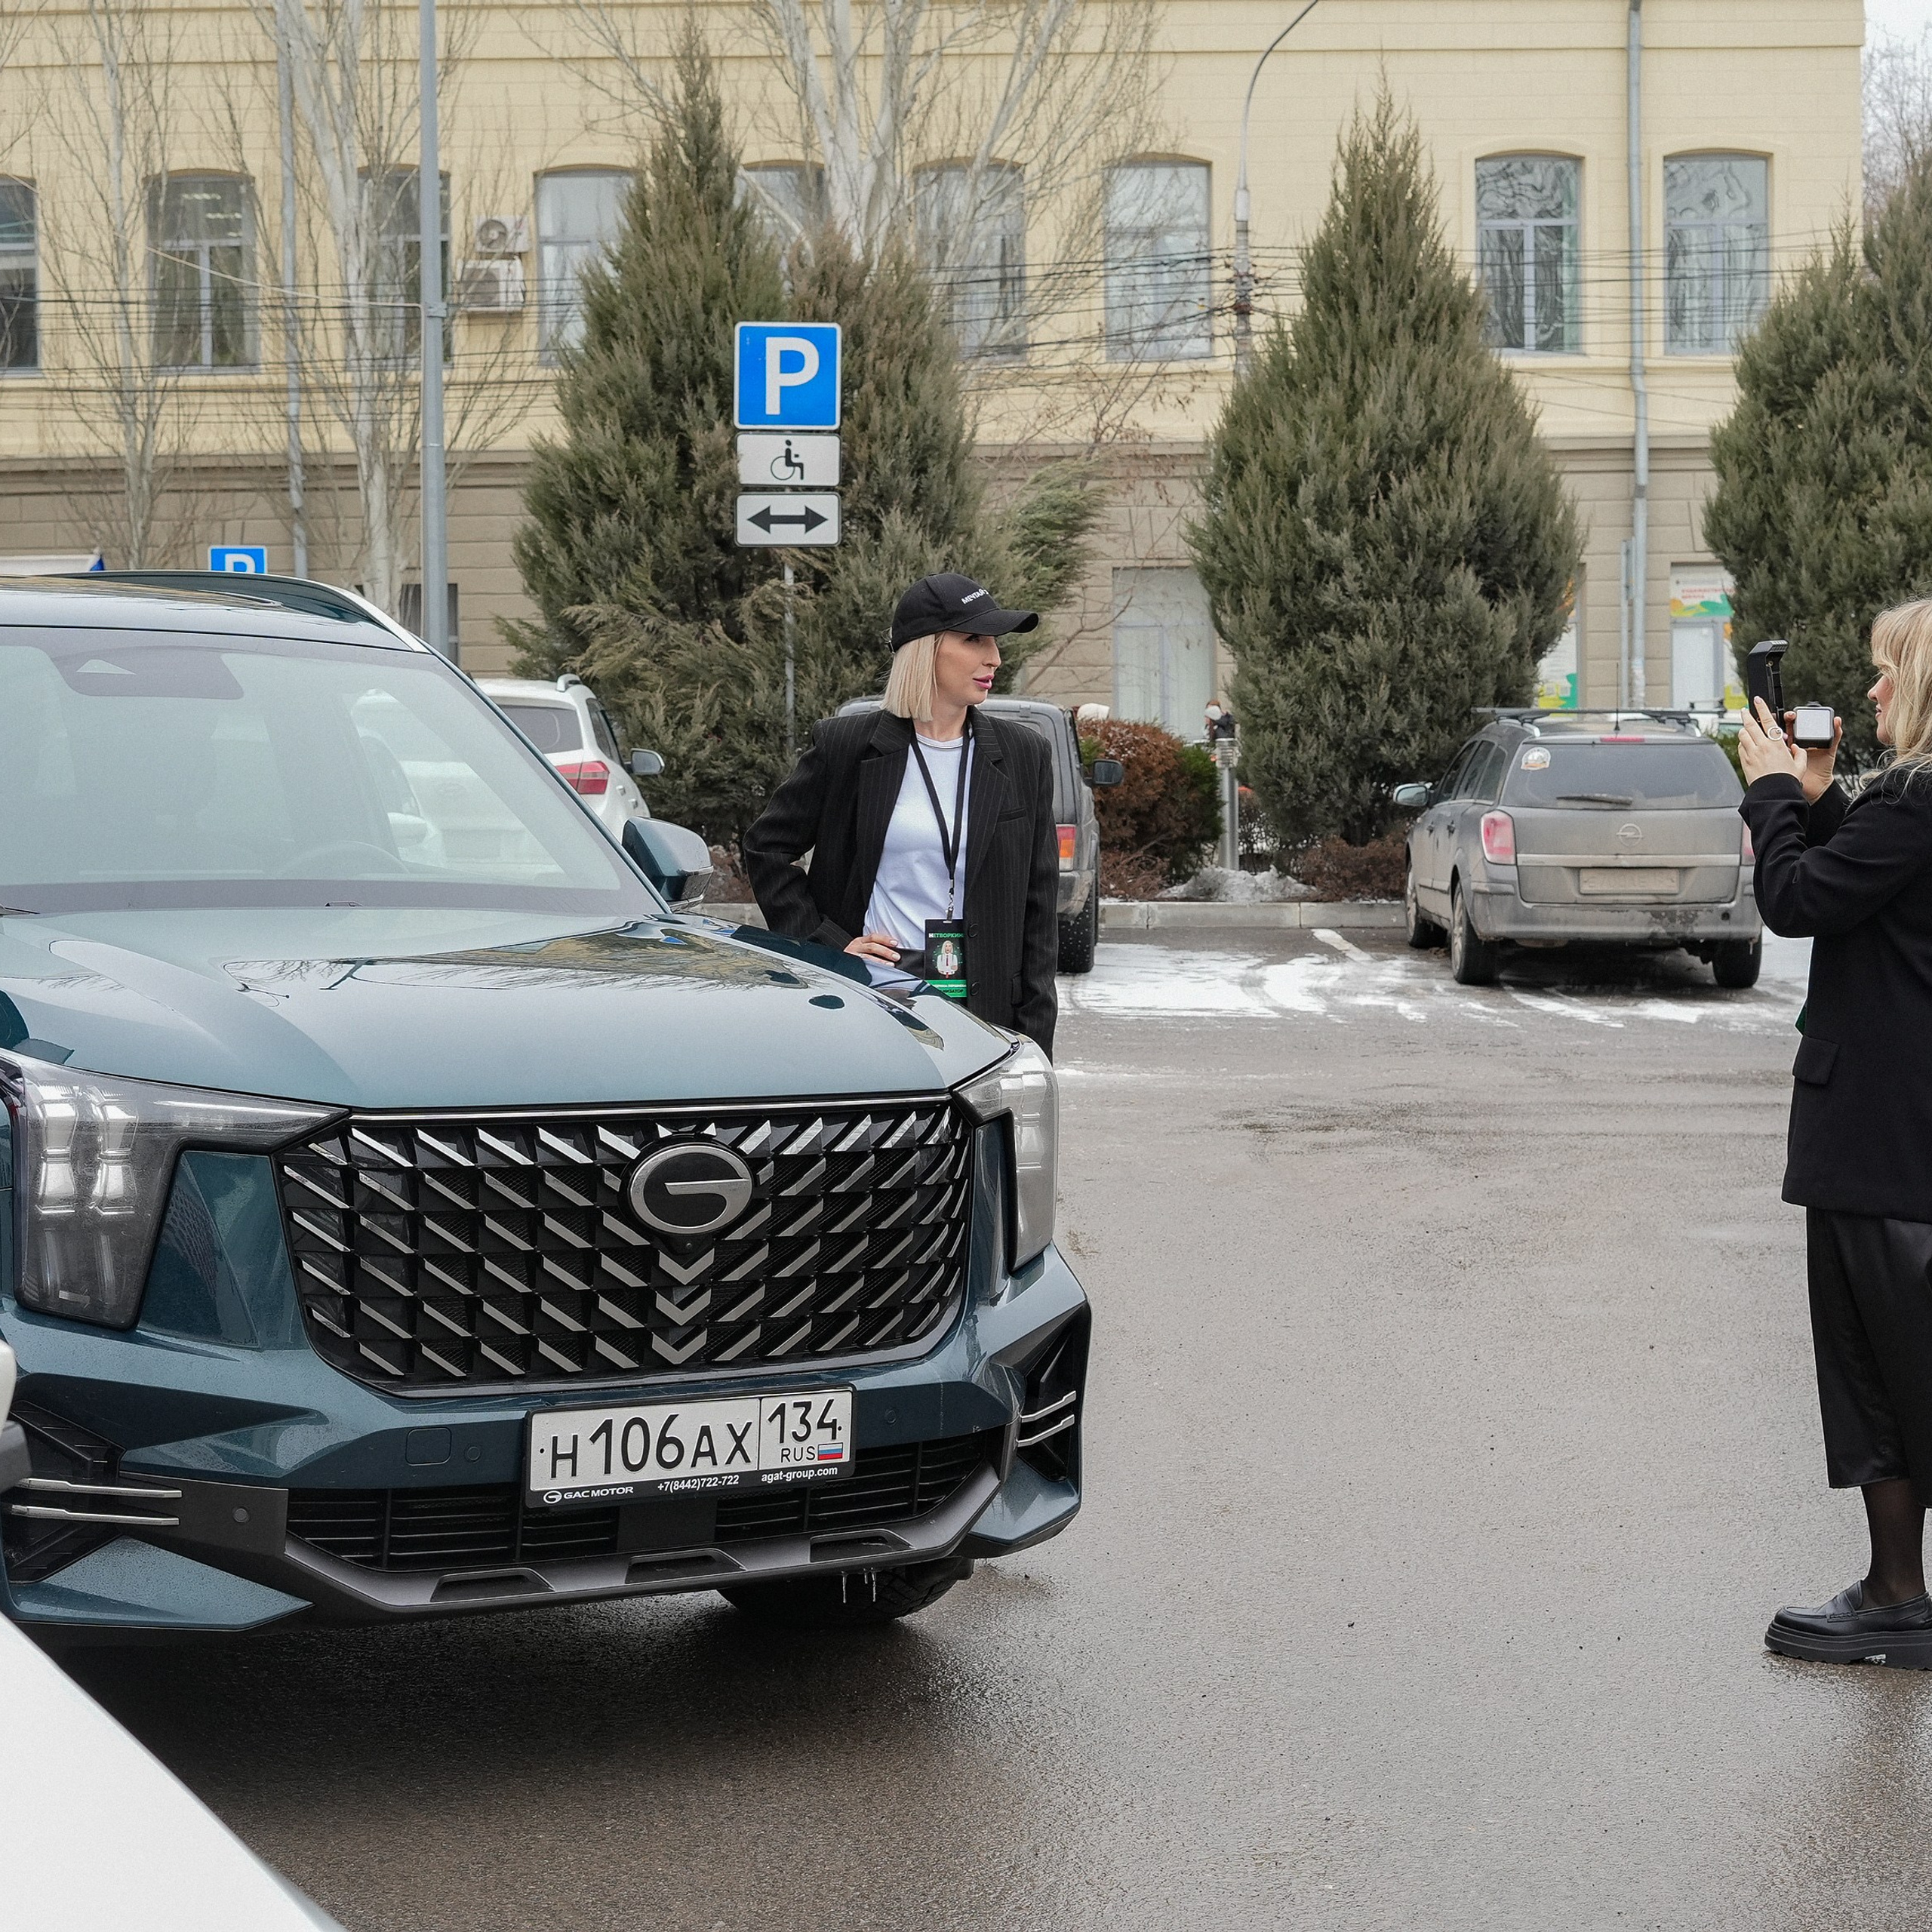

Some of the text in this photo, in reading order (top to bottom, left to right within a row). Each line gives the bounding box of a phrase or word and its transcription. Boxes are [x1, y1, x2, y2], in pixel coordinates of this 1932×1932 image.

[765, 337, 820, 415] P
[768, 1398, 838, 1444] 134
[780, 1445, 816, 1463] RUS
[761, 1466, 838, 1483] agat-group.com
[563, 1490, 591, 1500] GAC
[591, 1486, 634, 1497] MOTOR
[657, 1475, 740, 1493] +7(8442)722-722
